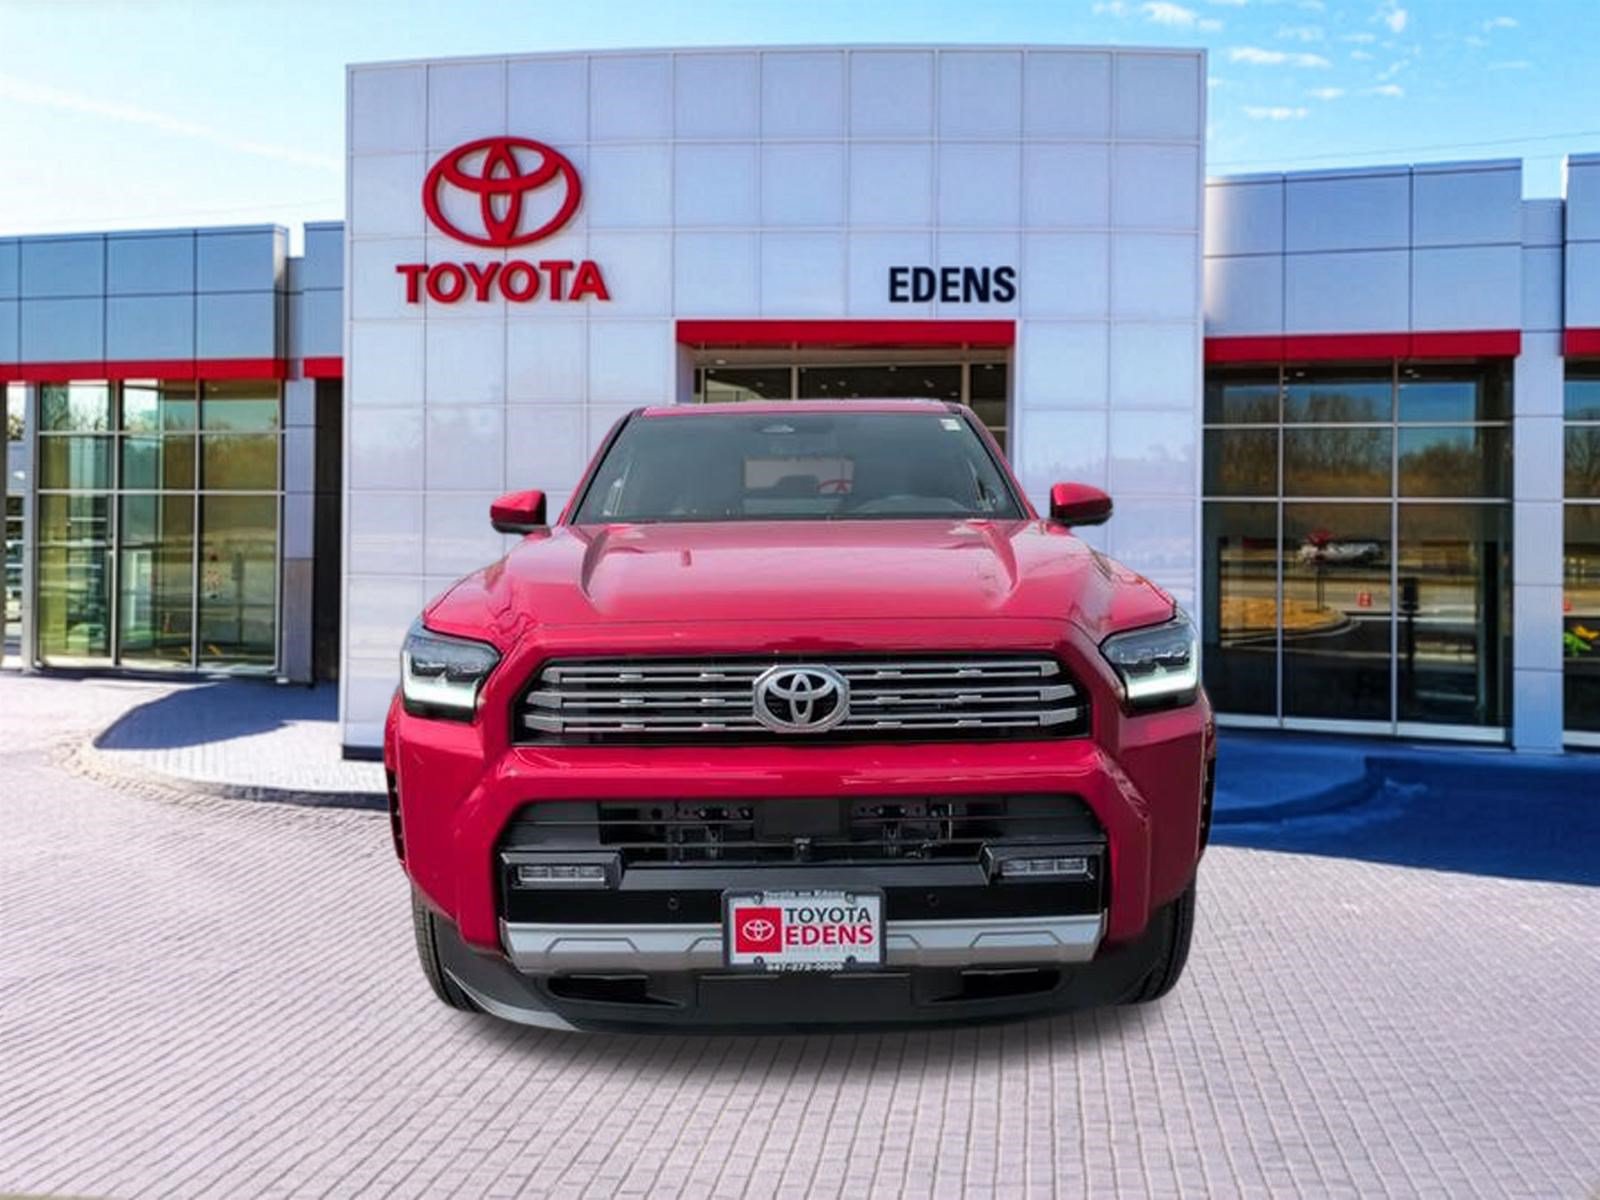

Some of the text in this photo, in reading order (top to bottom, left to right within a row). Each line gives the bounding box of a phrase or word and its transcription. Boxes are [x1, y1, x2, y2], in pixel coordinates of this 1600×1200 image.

[396, 259, 609, 304] TOYOTA
[889, 266, 1017, 303] EDENS
[785, 907, 872, 924] TOYOTA
[784, 924, 874, 946] EDENS
